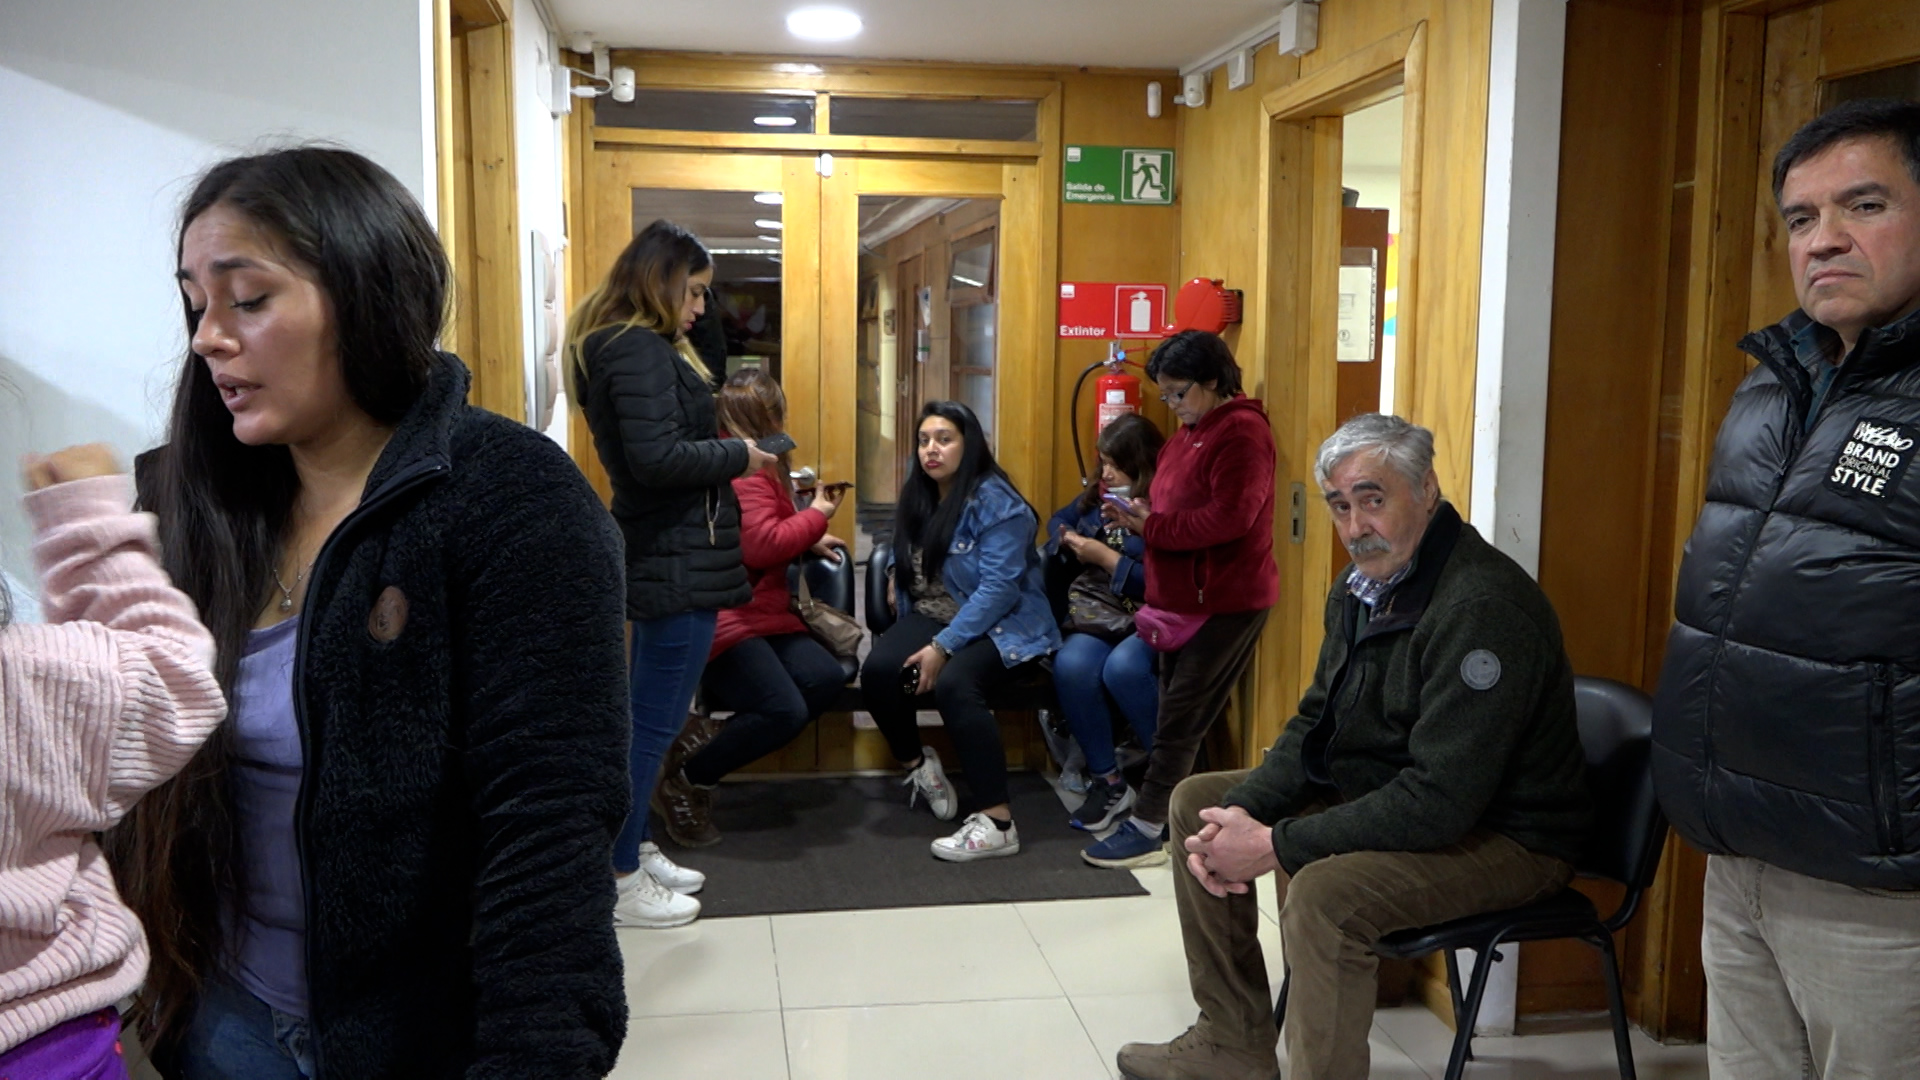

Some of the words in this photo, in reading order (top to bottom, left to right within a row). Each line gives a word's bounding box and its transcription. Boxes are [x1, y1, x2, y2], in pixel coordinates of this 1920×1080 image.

[1060, 325, 1106, 336] Extintor
[1843, 441, 1900, 468] BRAND
[1839, 455, 1891, 480] ORIGINAL
